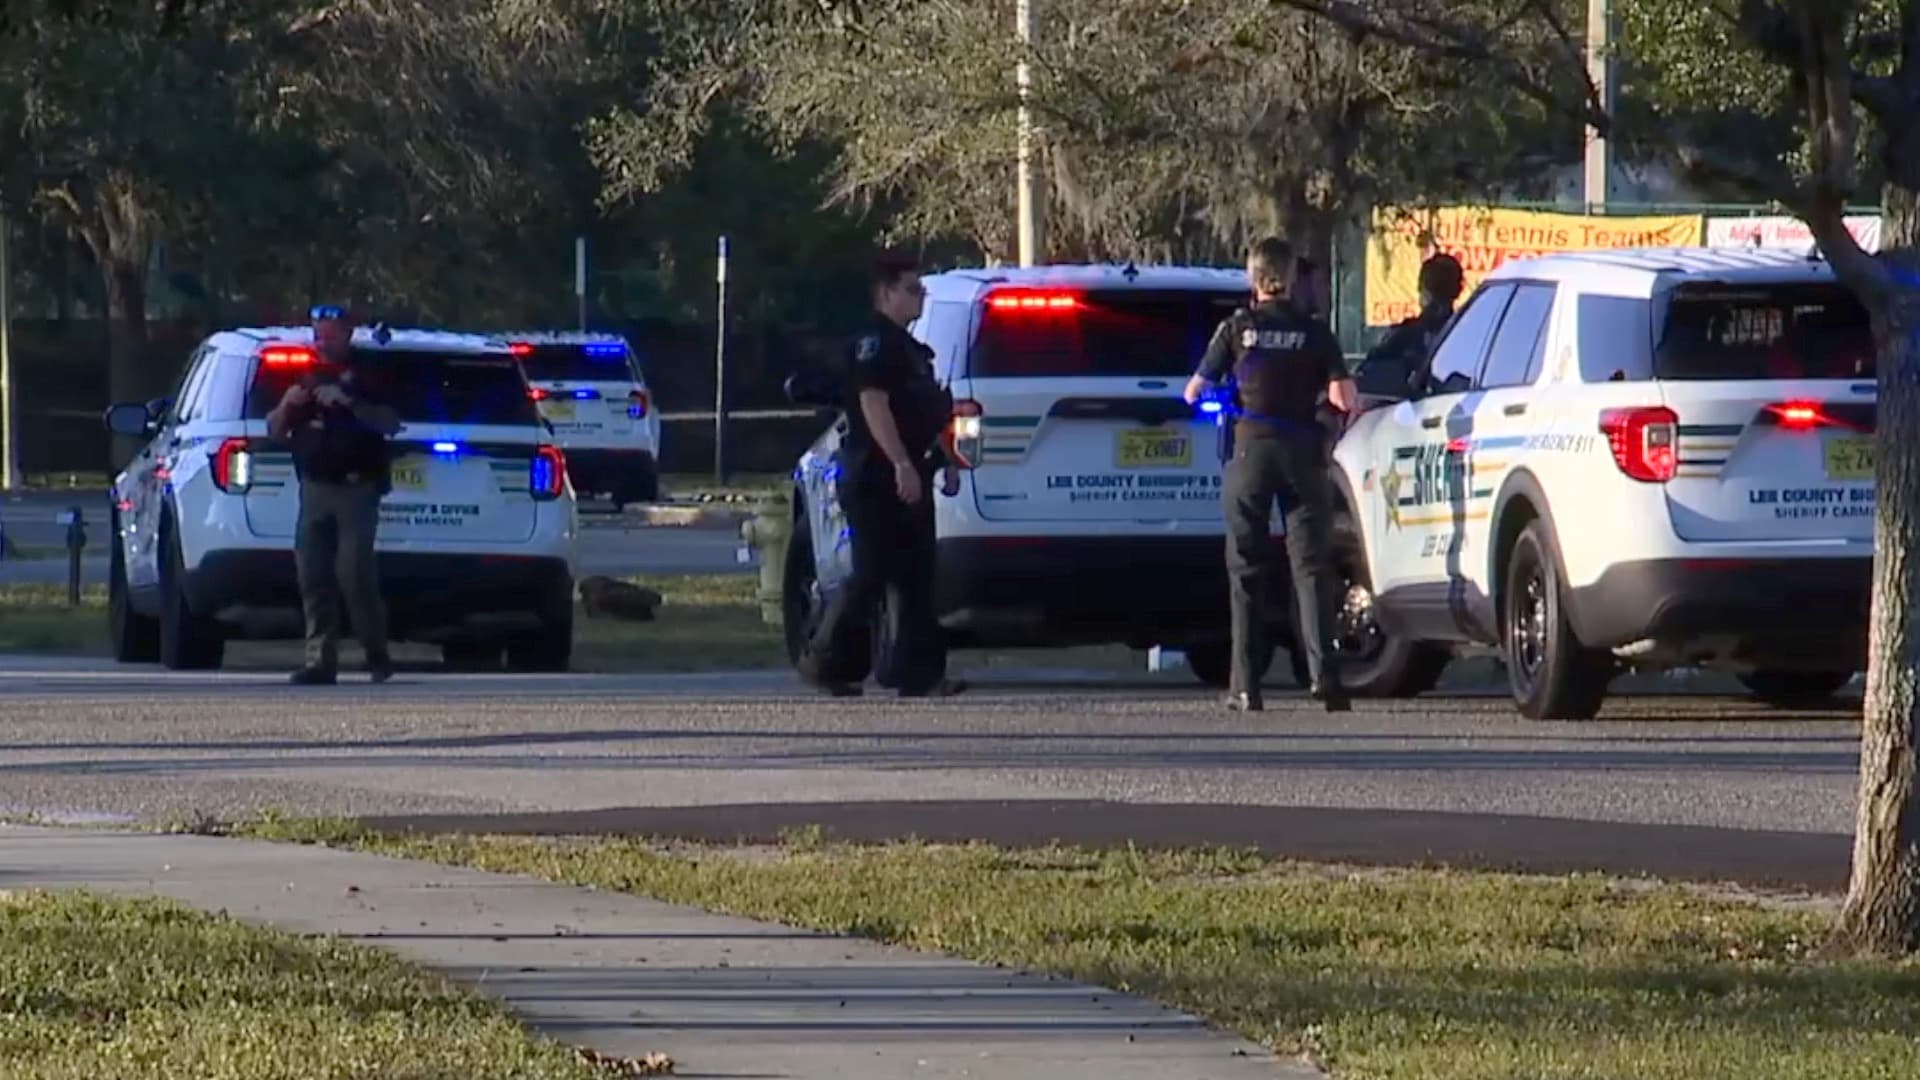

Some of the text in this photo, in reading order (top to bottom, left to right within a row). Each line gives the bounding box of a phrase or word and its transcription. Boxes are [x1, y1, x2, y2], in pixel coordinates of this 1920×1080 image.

[1478, 217, 1568, 246] Tennis
[1579, 223, 1670, 248] Teams
[1242, 328, 1306, 349] SHERIFF
[1077, 475, 1134, 488] COUNTY
[1069, 491, 1117, 502] SHERIFF
[1783, 488, 1845, 503] COUNTY
[1775, 506, 1828, 519] SHERIFF
